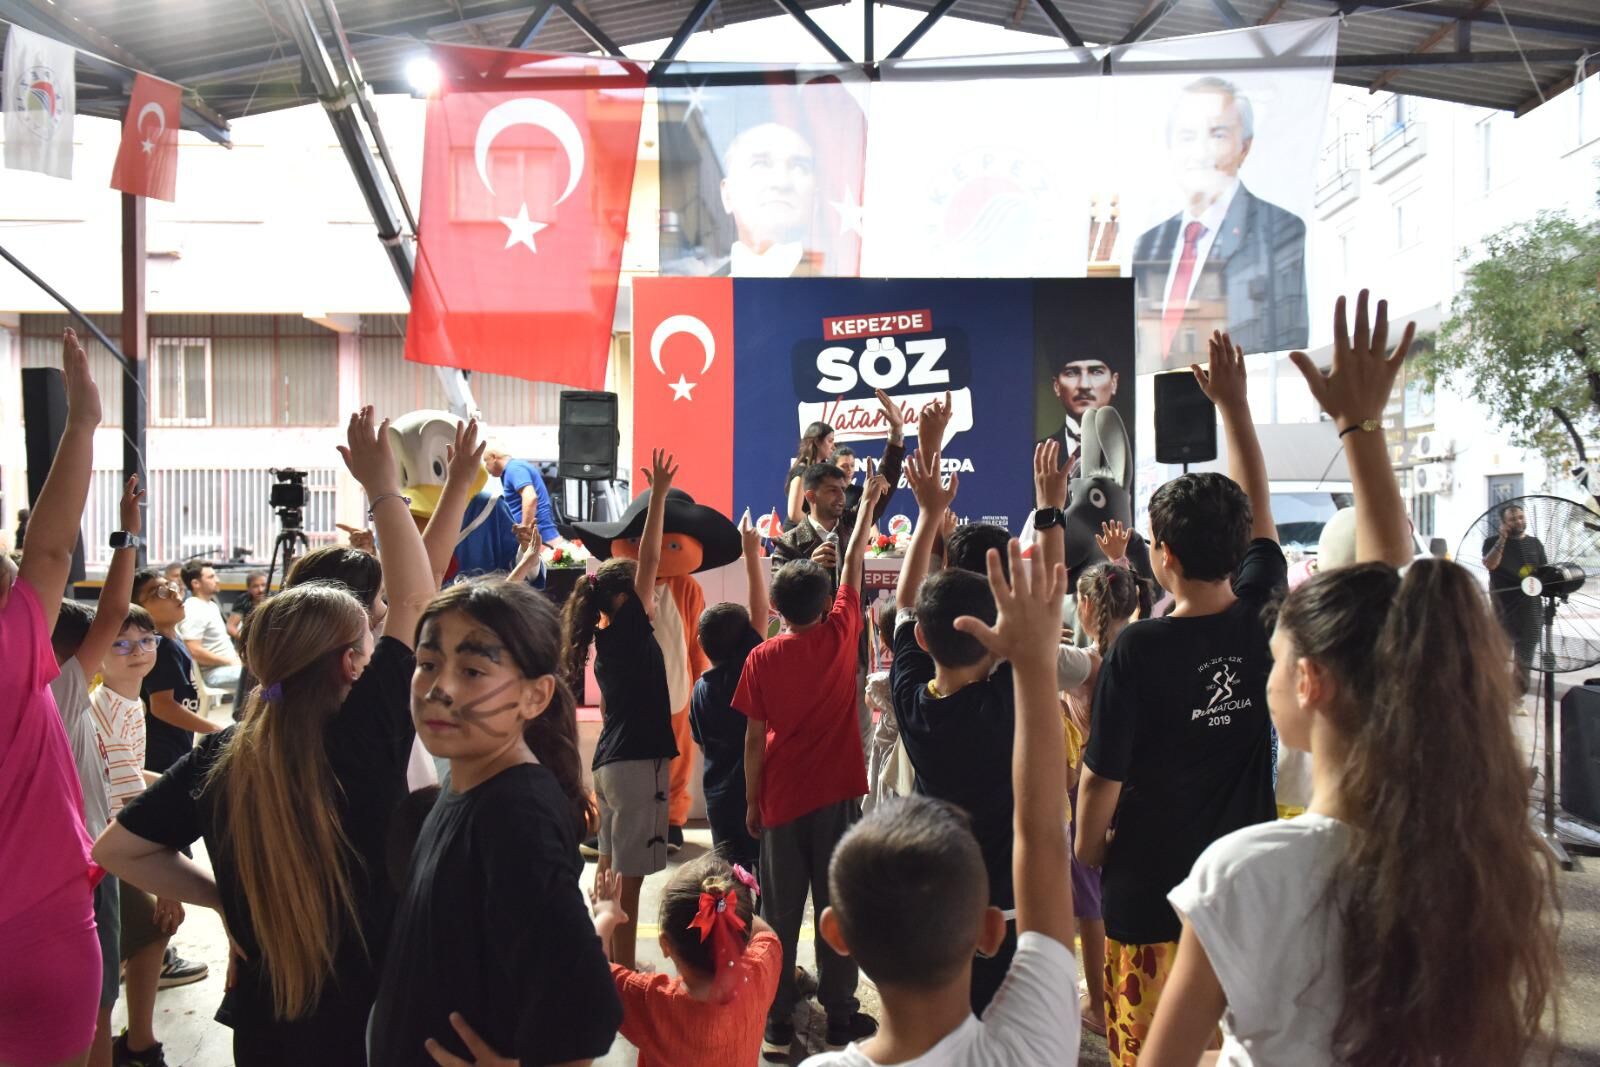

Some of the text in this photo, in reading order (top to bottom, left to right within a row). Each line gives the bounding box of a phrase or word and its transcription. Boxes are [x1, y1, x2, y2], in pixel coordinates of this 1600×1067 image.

[831, 313, 924, 336] KEPEZ'DE
[816, 337, 950, 394] SÖZ
[1208, 714, 1231, 727] 2019
